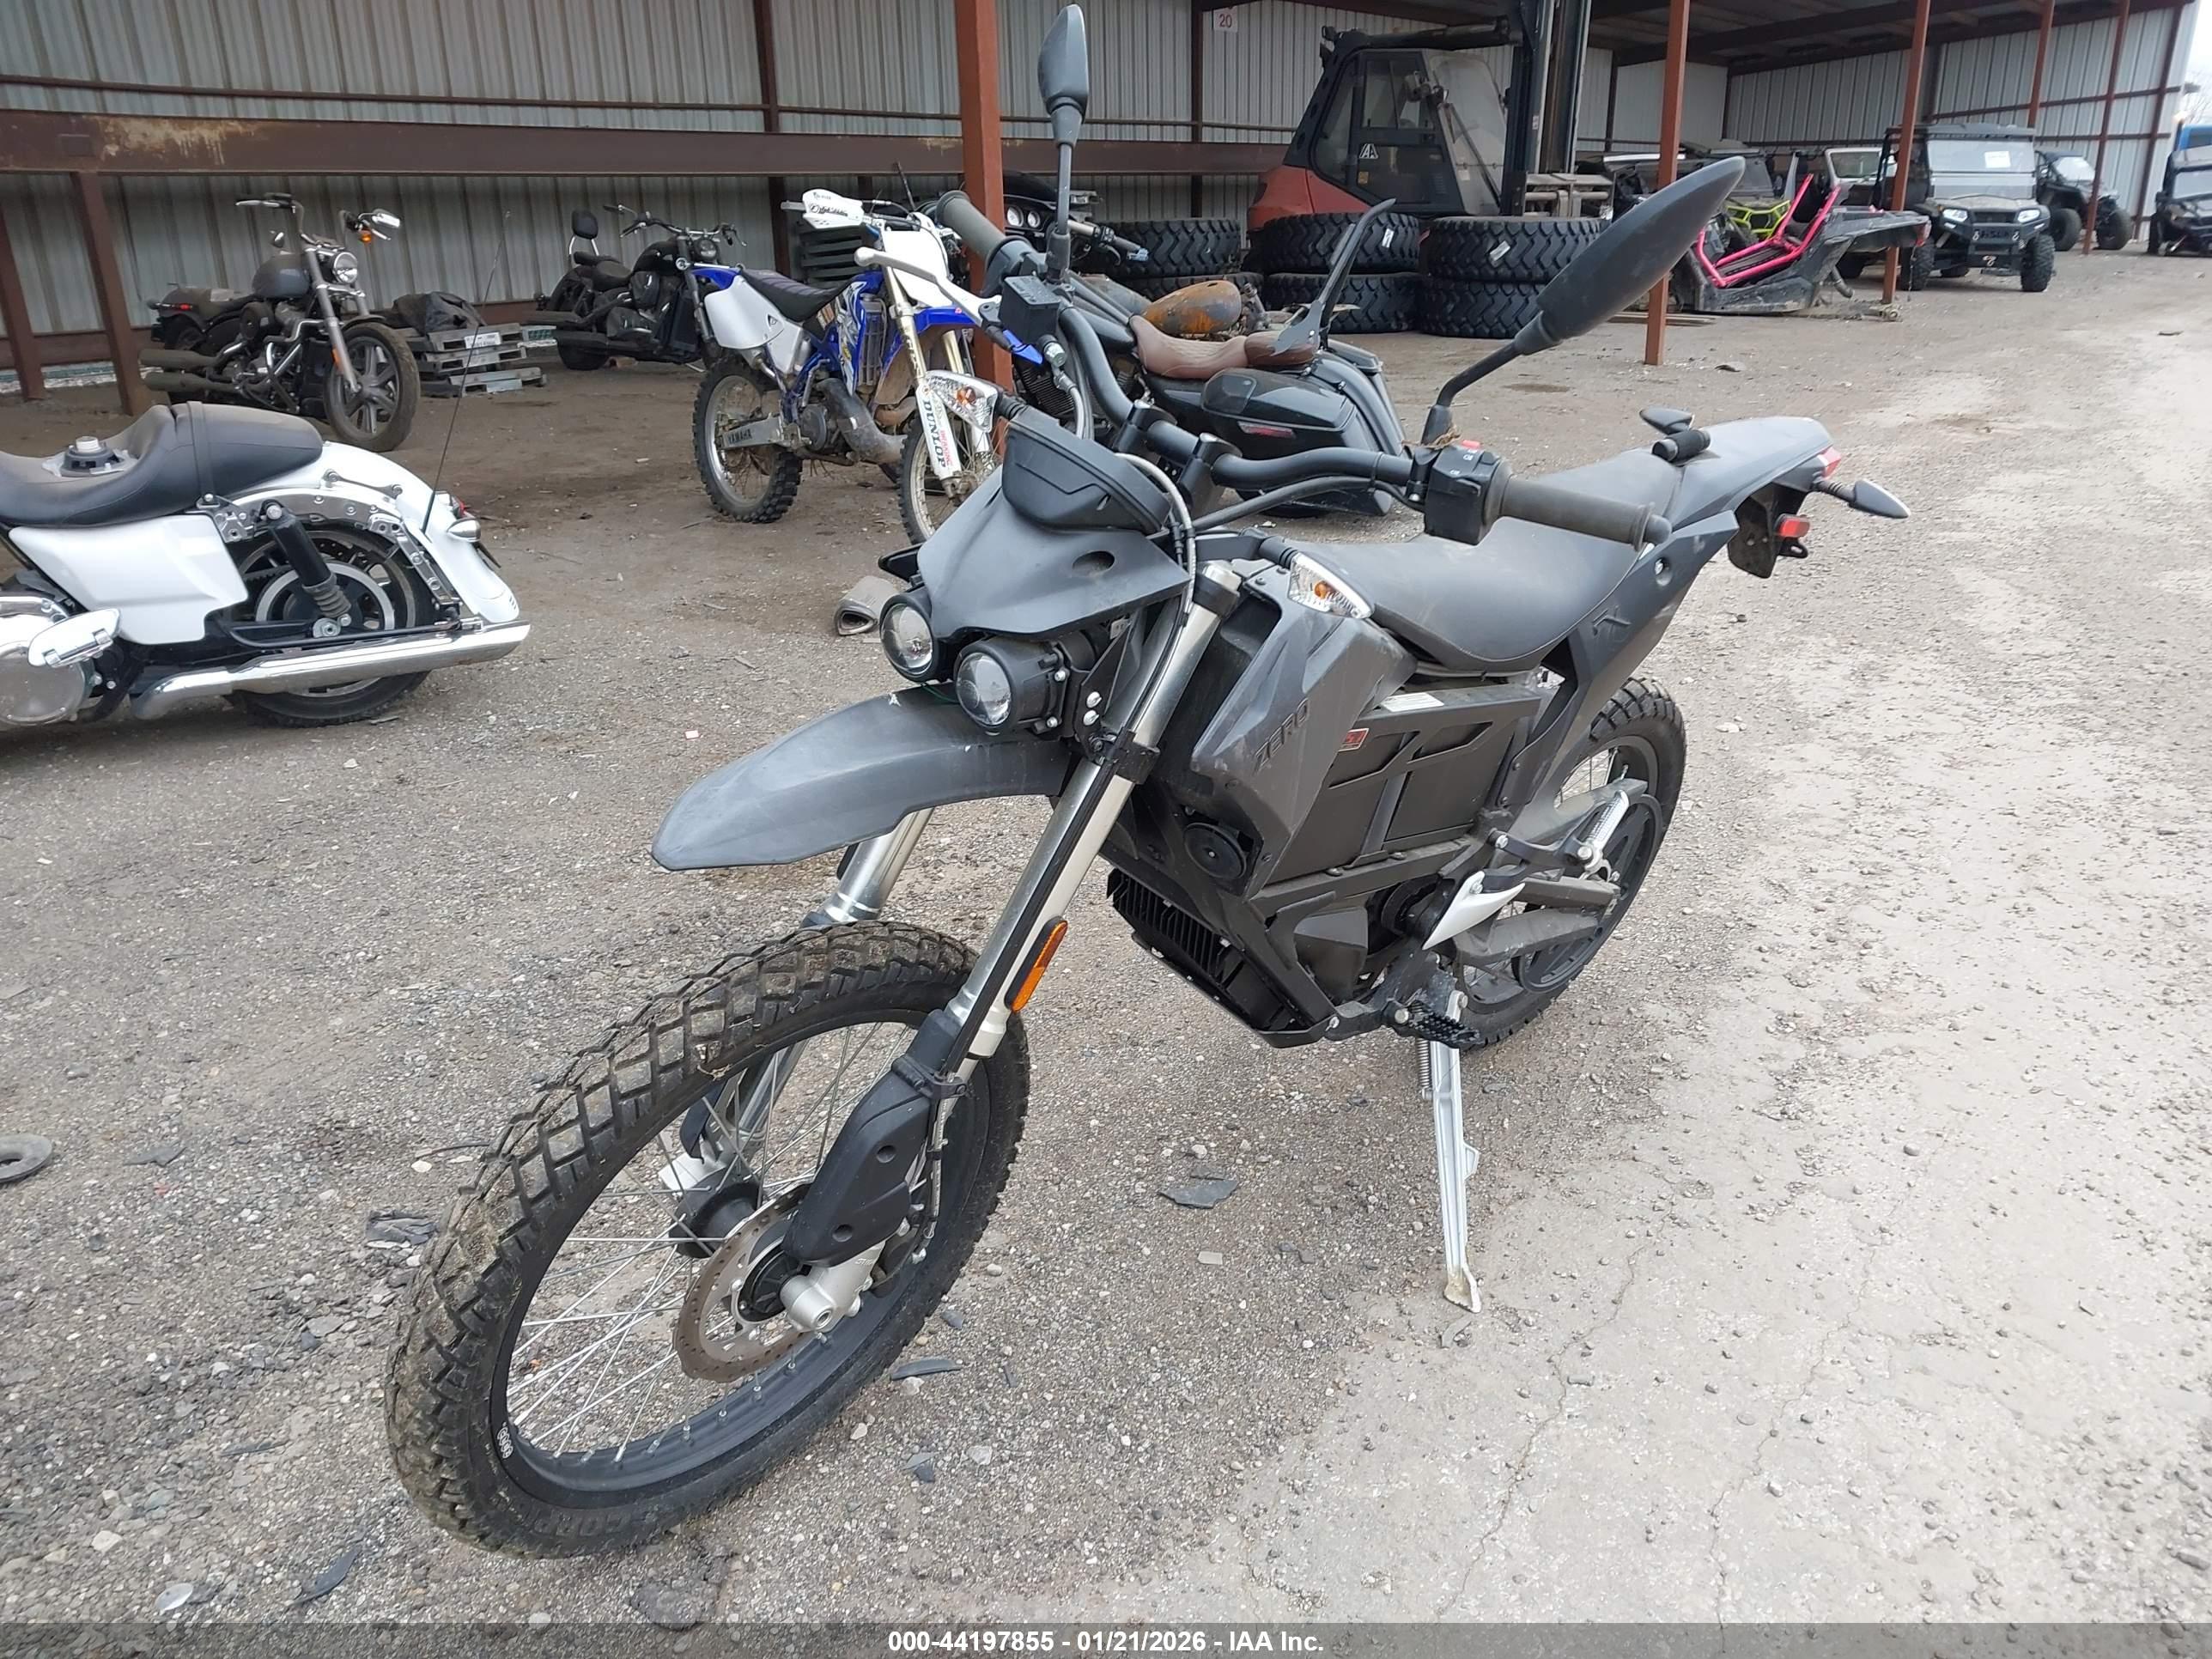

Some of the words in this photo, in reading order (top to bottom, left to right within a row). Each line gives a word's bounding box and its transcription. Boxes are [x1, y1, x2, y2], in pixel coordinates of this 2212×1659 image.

[1218, 13, 1233, 28] 20
[922, 398, 947, 468] DUNLOP
[1253, 697, 1310, 769] ZERO
